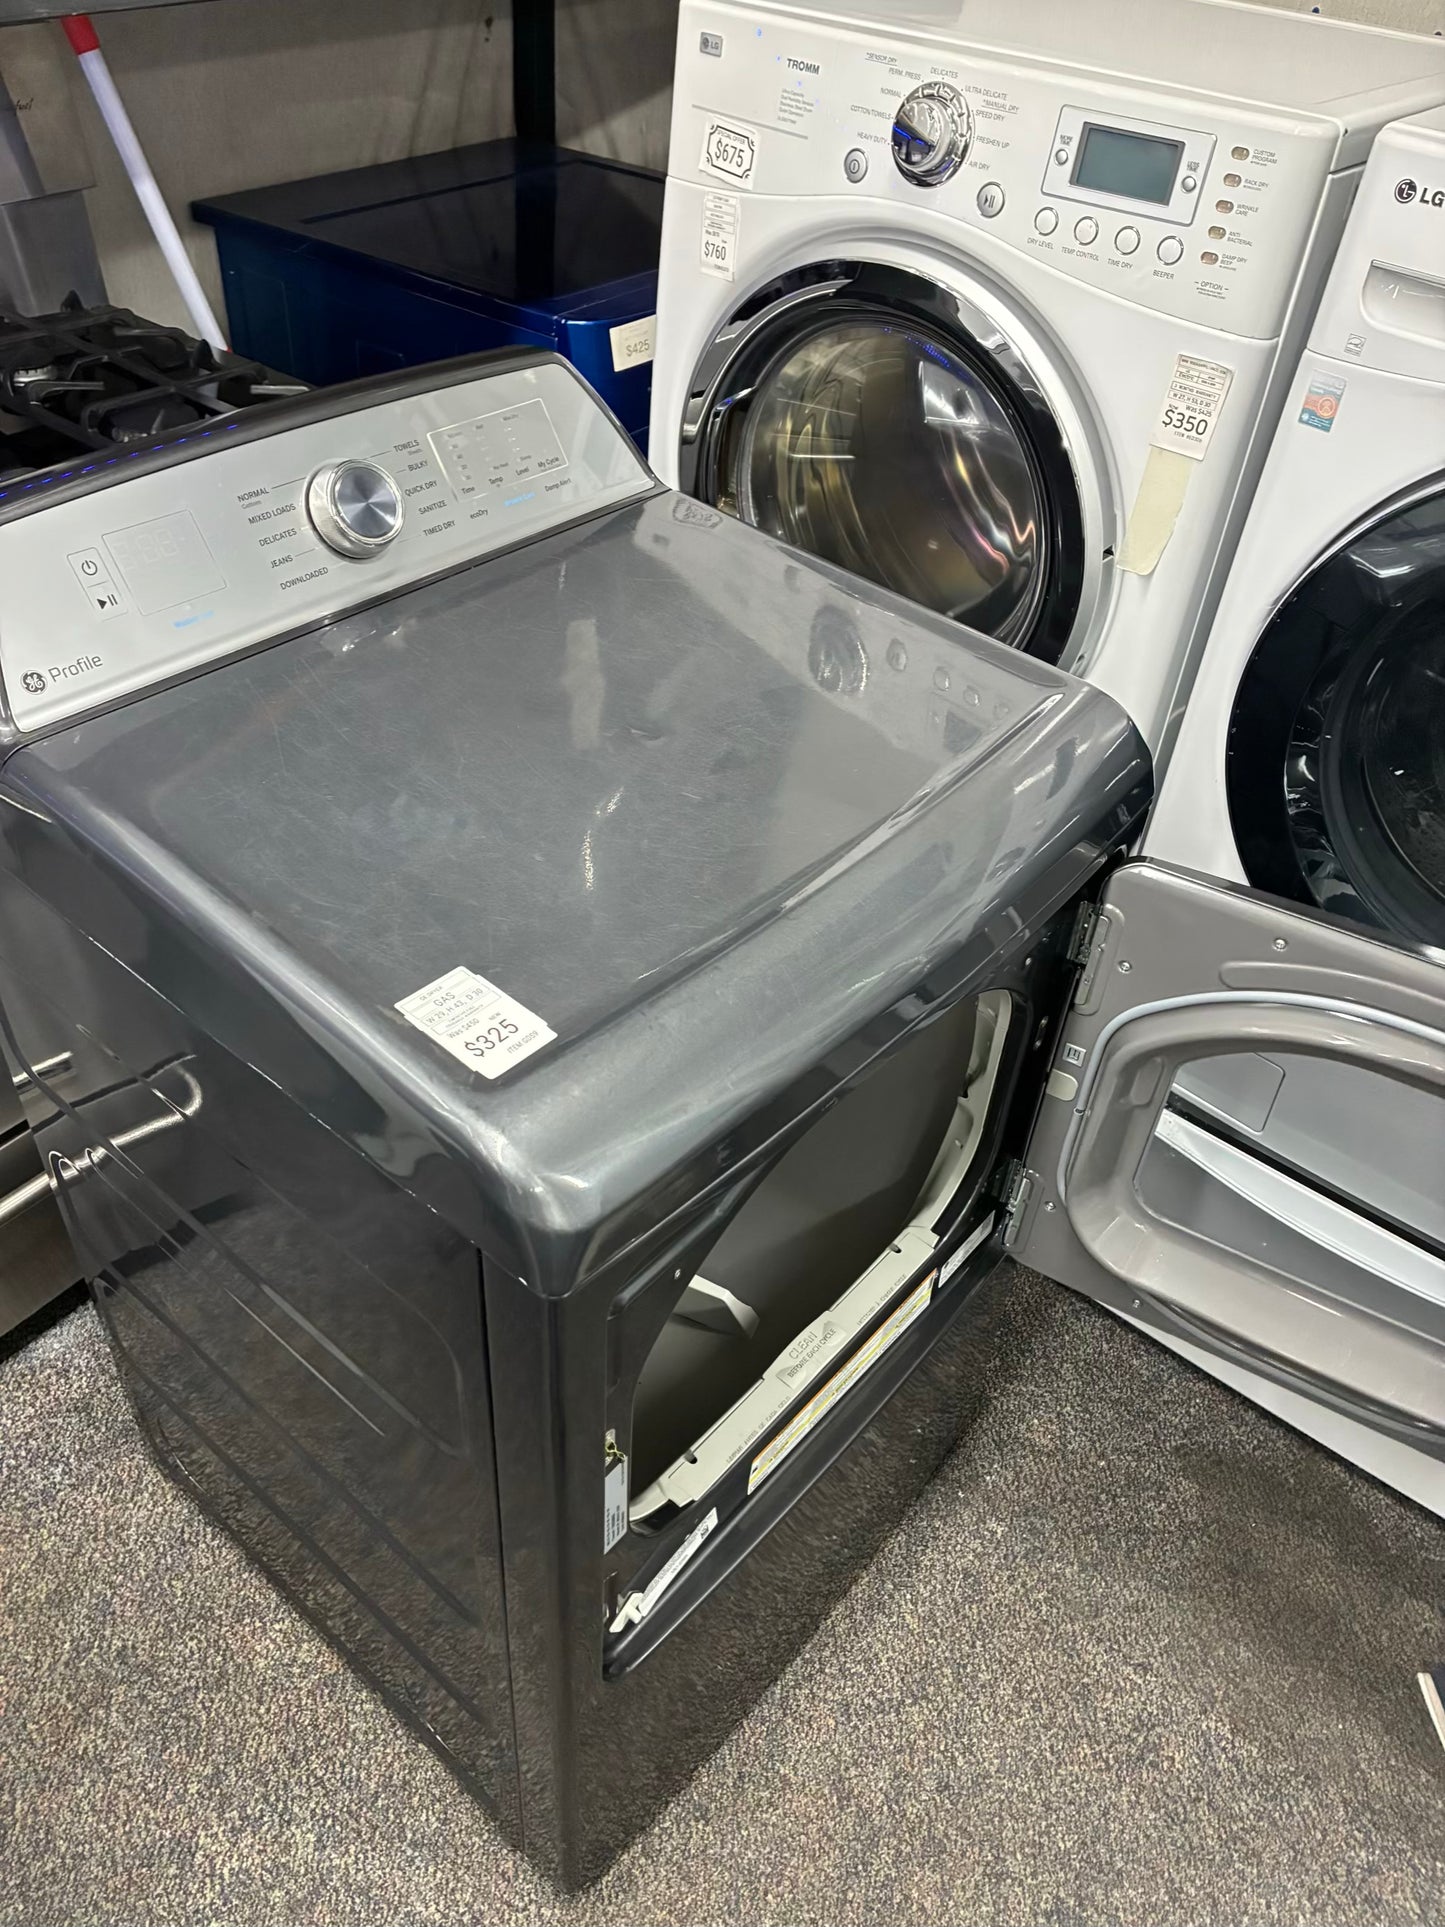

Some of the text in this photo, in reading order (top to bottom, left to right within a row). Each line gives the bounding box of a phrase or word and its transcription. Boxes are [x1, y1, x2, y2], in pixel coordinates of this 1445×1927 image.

[710, 40, 720, 50] LG
[786, 58, 820, 75] TROMM
[930, 67, 959, 79] DELICATES
[904, 71, 921, 80] PRESS
[880, 88, 902, 98] NORMAL
[965, 85, 1008, 101] ULTRA DELICATE
[1008, 104, 1019, 112] DRY
[975, 109, 1005, 121] SPEED DRY
[857, 132, 888, 145] HEAVY DUTY
[976, 135, 1010, 149] FRESHEN UP
[715, 137, 745, 168] $675
[1253, 149, 1276, 157] CUSTOM
[969, 161, 990, 171] AIR DRY
[1252, 155, 1278, 164] PROGRAM
[1244, 178, 1258, 187] RACK
[1258, 181, 1269, 189] DRY
[1419, 187, 1445, 208] LG
[1235, 209, 1249, 217] CARE
[1237, 204, 1259, 213] WRINKLE
[1027, 237, 1054, 250] DRY LEVEL
[1227, 236, 1253, 247] BACTERIAL
[704, 240, 727, 260] $760
[1076, 250, 1099, 262] CONTROL
[1107, 258, 1134, 270] TIME DRY
[1152, 269, 1175, 280] BEEPER
[1200, 280, 1224, 291] OPTION
[625, 338, 650, 357] $425
[1162, 408, 1208, 436] $350
[393, 439, 420, 452] TOWELS
[407, 459, 428, 472] BULKY
[546, 456, 560, 466] Cycle
[515, 467, 530, 476] Level
[488, 476, 504, 485] Temp
[404, 480, 438, 497] QUICK DRY
[461, 485, 475, 494] Time
[544, 483, 560, 493] Damp
[237, 487, 270, 503] NORMAL
[248, 503, 297, 525] MIXED LOADS
[418, 500, 448, 515] SANITIZE
[470, 508, 489, 520] ecoDry
[423, 519, 457, 537] TIMED DRY
[258, 528, 297, 547] DELICATES
[270, 554, 294, 569] JEANS
[280, 566, 329, 591] DOWNLOADED
[48, 654, 104, 683] Profile
[433, 991, 456, 1007] GAS
[426, 1015, 436, 1024] W
[466, 993, 474, 1001] D
[448, 1028, 463, 1039] Was
[461, 1017, 480, 1032] $450
[463, 1018, 519, 1058] $325
[506, 1041, 523, 1054] ITEM
[788, 1330, 819, 1361] CLEAN
[786, 1327, 837, 1379] BEFORE EACH CYCLE
